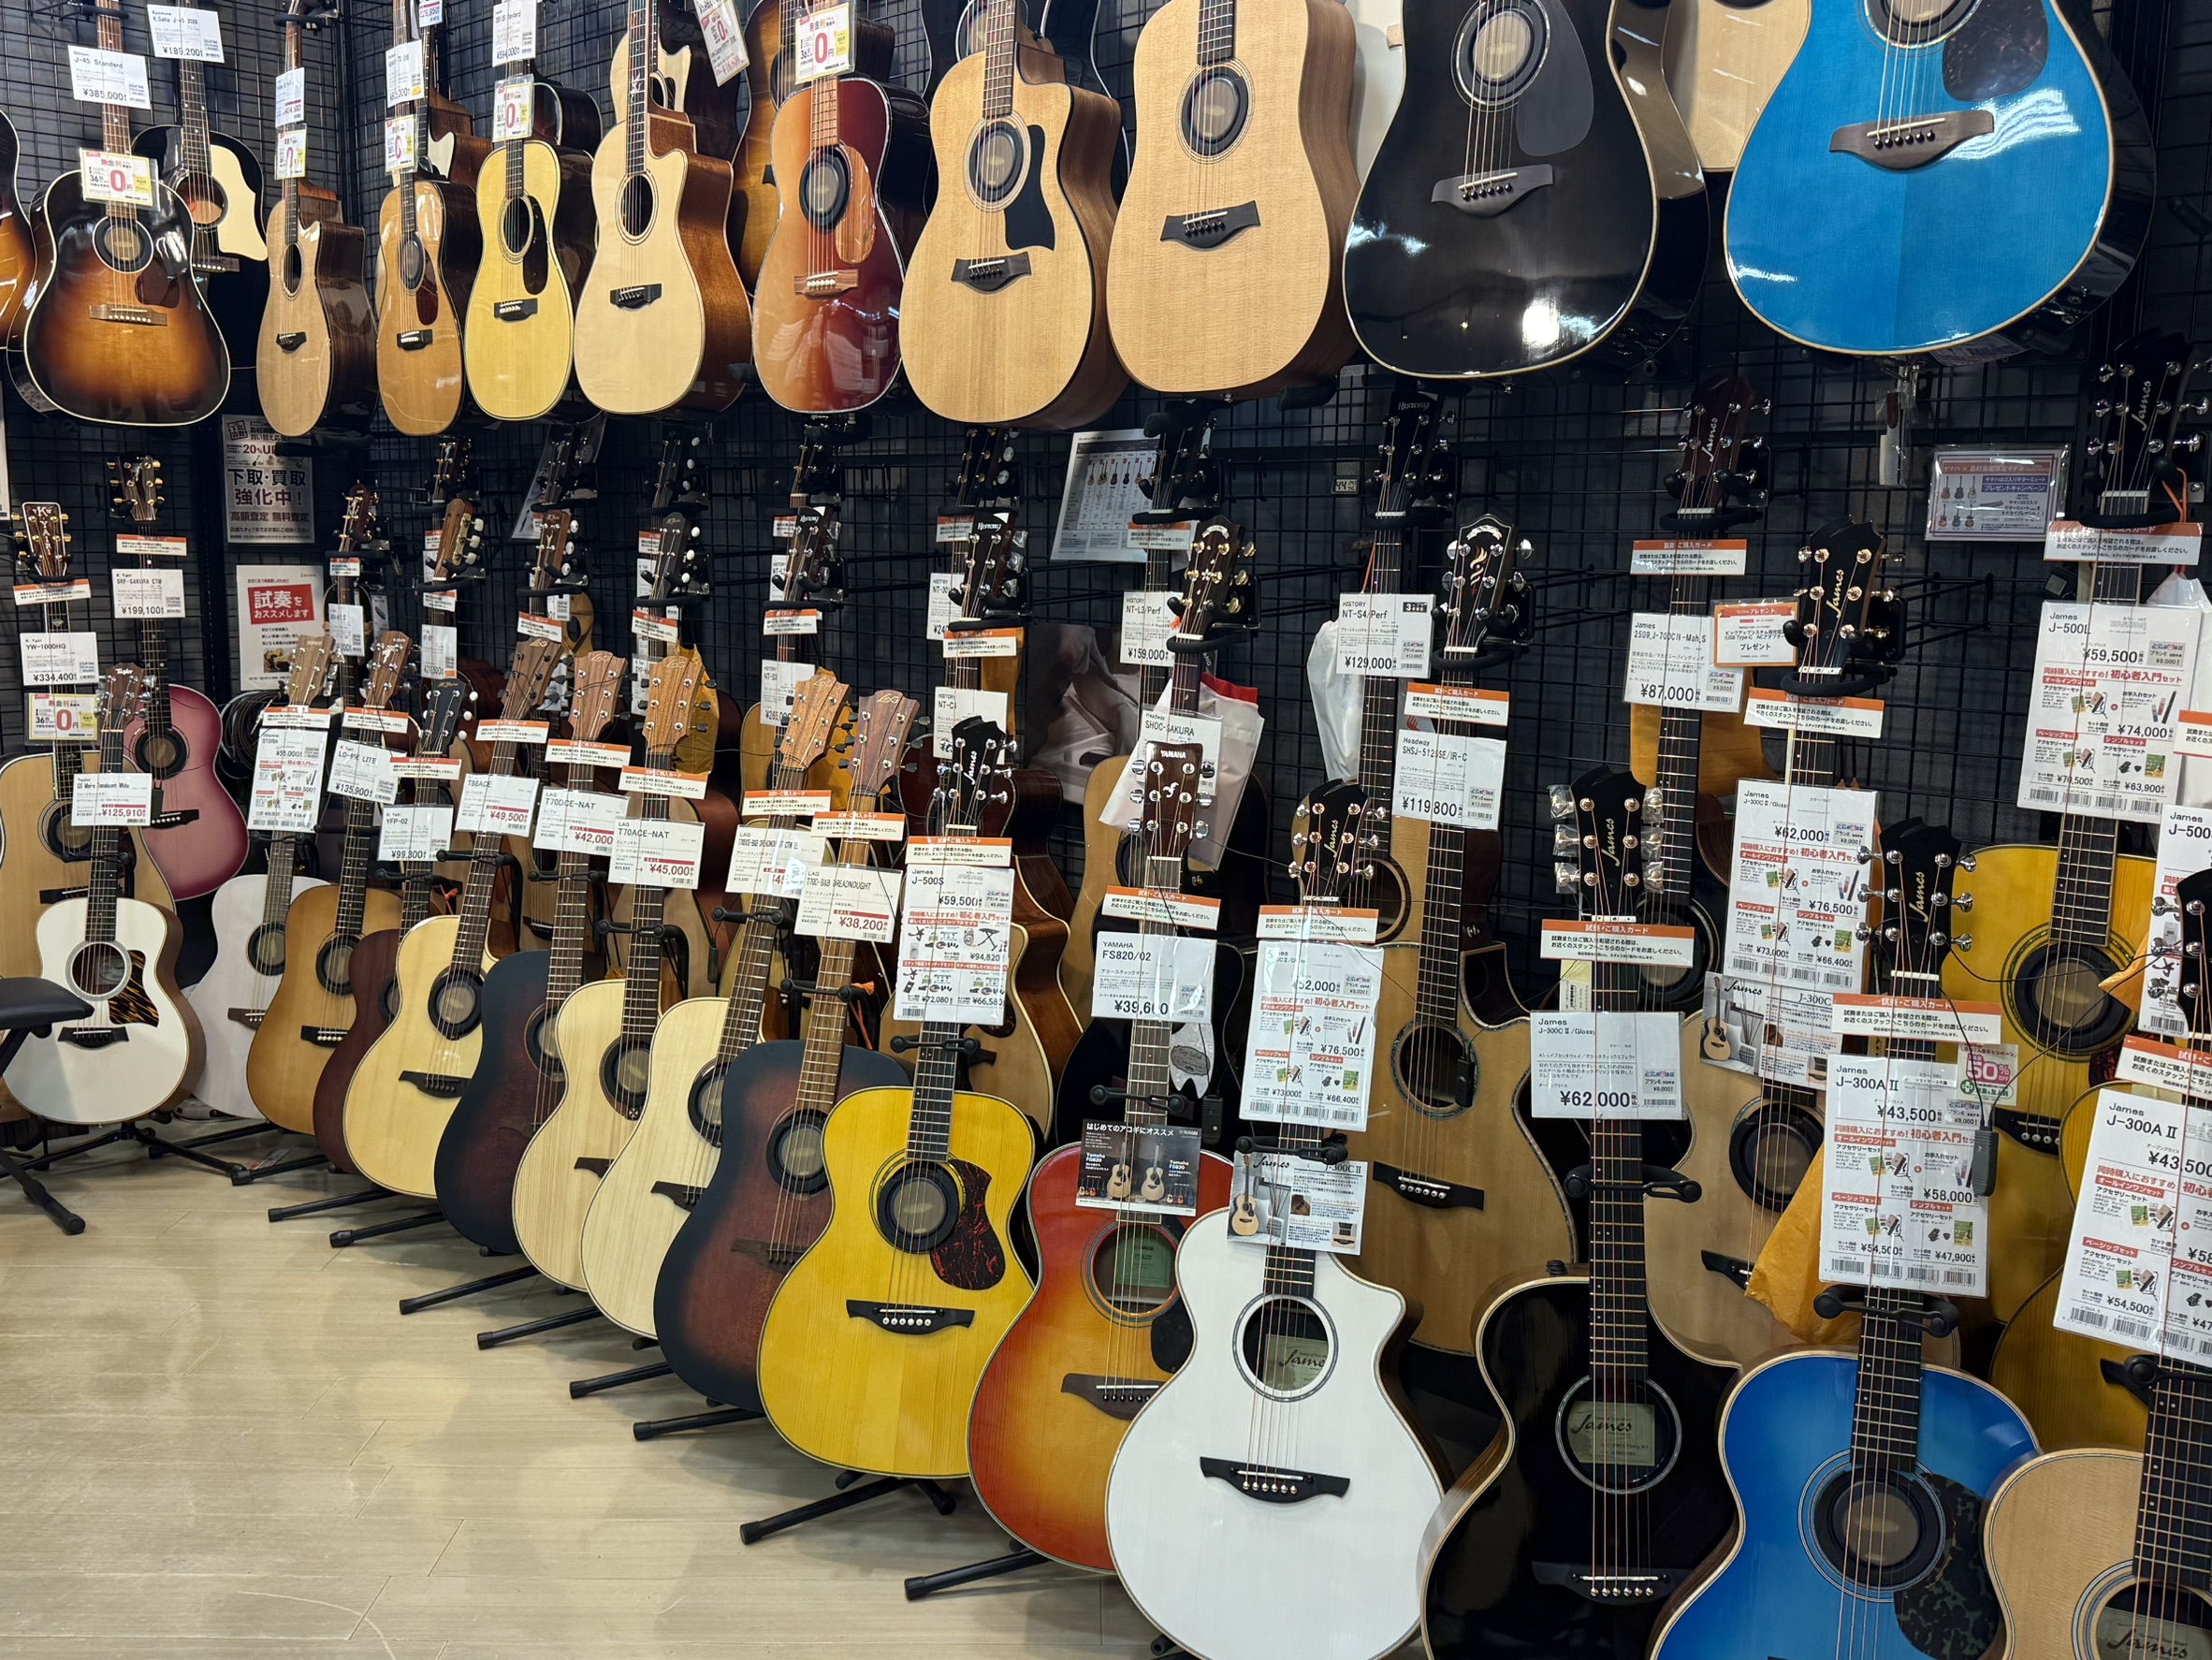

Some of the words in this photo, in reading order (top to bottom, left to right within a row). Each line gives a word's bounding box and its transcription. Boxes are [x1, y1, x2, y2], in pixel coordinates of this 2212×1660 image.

[2132, 380, 2151, 431] James
[227, 469, 306, 486] 下取・買取
[235, 488, 301, 505] 強化中！
[254, 590, 302, 608] 試奏を
[1826, 569, 1844, 619] James
[122, 606, 160, 615] ¥199,100
[255, 609, 309, 619] おススメします
[2050, 612, 2077, 620] James
[1128, 647, 1165, 661] ¥159,000
[2083, 648, 2138, 663] ¥59,500
[1345, 656, 1392, 670] ¥129,000
[34, 673, 74, 681] ¥334,400
[2111, 669, 2183, 683] 初心者入門セット
[1640, 683, 1695, 702] ¥87,000
[2117, 724, 2167, 738] ¥74,000
[336, 782, 370, 796] ¥135,900
[2125, 781, 2161, 794] ¥63,900
[1744, 791, 1769, 799] James
[490, 810, 524, 823] ¥49,500
[2170, 811, 2203, 823] James
[575, 832, 613, 844] ¥42,000
[1774, 826, 1824, 842] ¥62,000
[2169, 823, 2212, 839] J-500
[1601, 818, 1620, 866] James
[649, 864, 690, 876] ¥45,000
[832, 880, 871, 891] DREADNOUGHT
[911, 877, 944, 885] J-500S
[939, 896, 979, 907] ¥59,500
[1909, 871, 1929, 923] James
[1809, 900, 1853, 914] ¥76,500
[839, 916, 883, 931] ¥38,200
[1103, 940, 1134, 949] YAMAHA
[969, 953, 1000, 962] ¥94,820
[1102, 950, 1152, 961] FS820/02
[1817, 955, 1849, 968] ¥66,400
[1320, 1043, 1361, 1056] ¥76,500
[1837, 1066, 1868, 1075] James
[1836, 1078, 1885, 1091] J-300A
[1327, 1094, 1356, 1104] ¥66,400
[1877, 1105, 1937, 1122] ¥43,500
[2109, 1102, 2145, 1116] James
[1086, 1123, 1174, 1136] はじめてのアコギにオススメ
[2106, 1114, 2161, 1136] J-300A
[1253, 1156, 1289, 1169] James
[1923, 1188, 1972, 1203] ¥58,000
[2096, 1187, 2147, 1202] アクセサリーセット
[1935, 1251, 1972, 1263] ¥47,900
[2083, 1249, 2133, 1266] アクセサリーセット
[2107, 1295, 2149, 1315] ¥54,500
[1278, 1349, 1326, 1367] Jame
